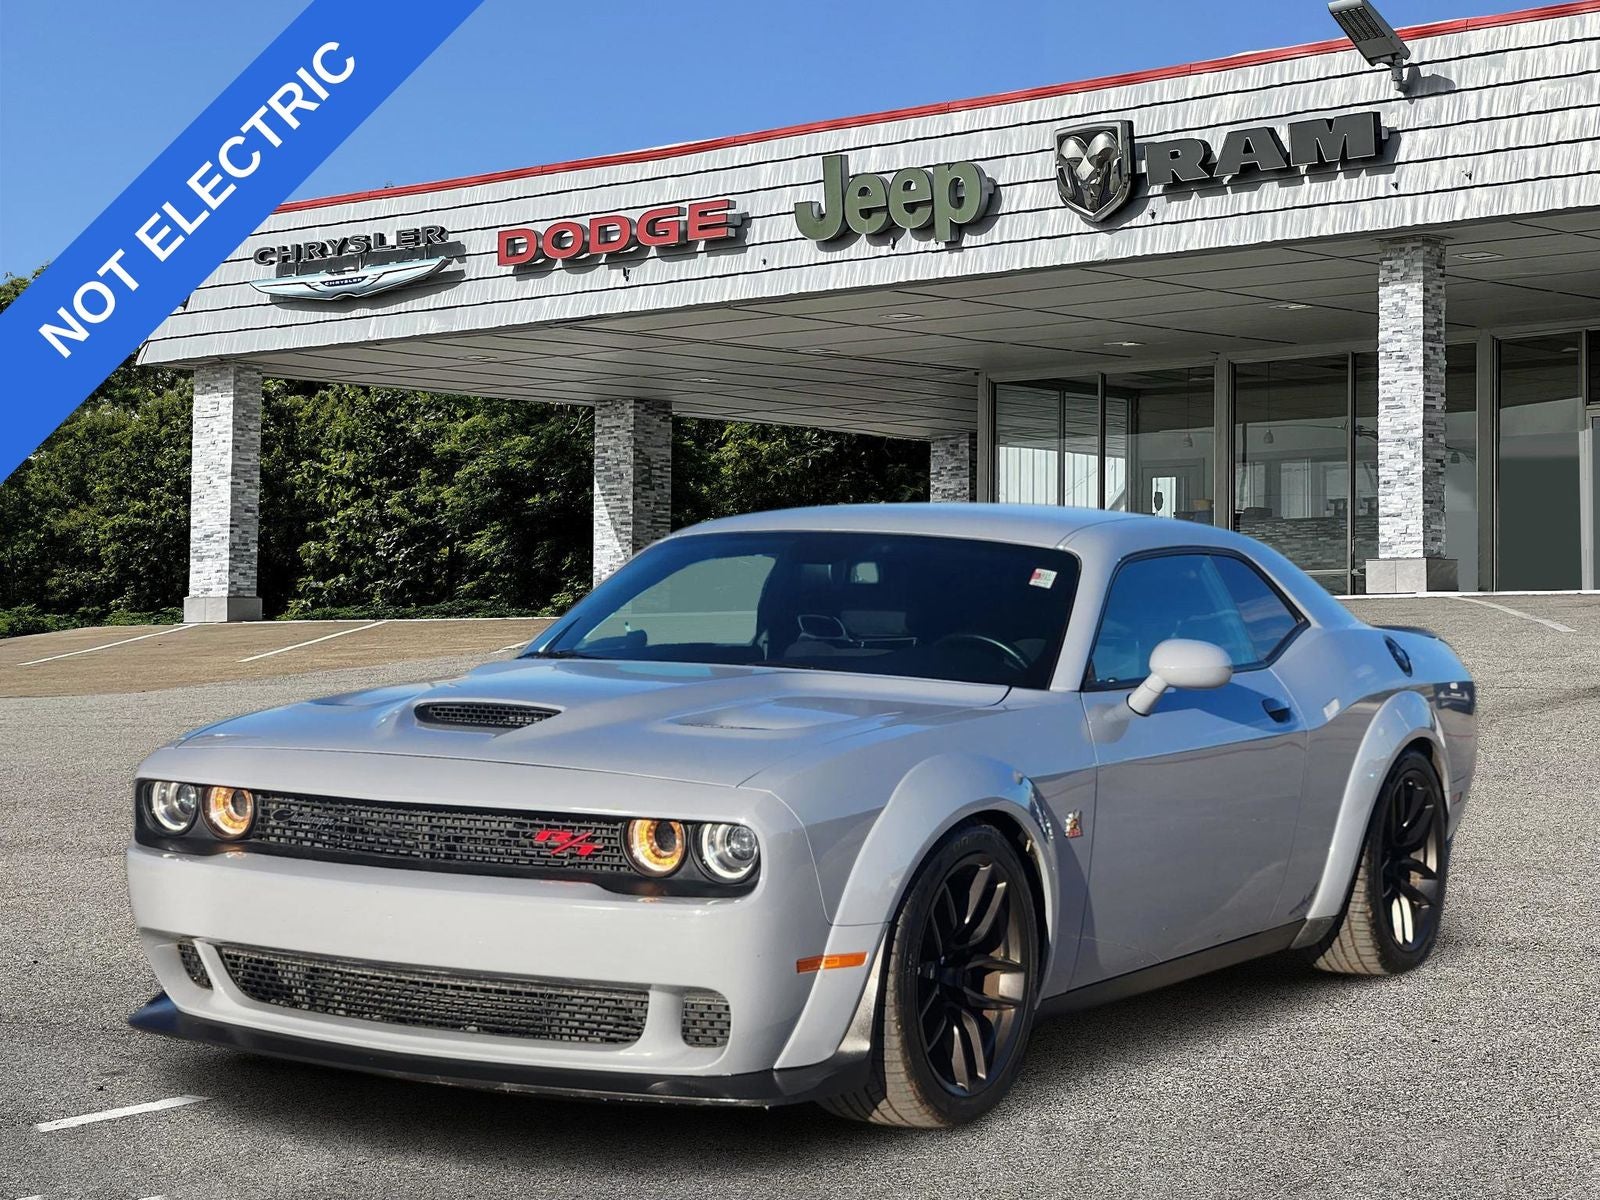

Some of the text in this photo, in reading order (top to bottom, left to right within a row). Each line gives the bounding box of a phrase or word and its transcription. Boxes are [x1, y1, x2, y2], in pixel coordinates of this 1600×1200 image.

[1145, 112, 1380, 186] RAM
[498, 199, 735, 266] DODGE
[794, 154, 988, 242] Jeep
[253, 224, 449, 266] CHRYSLER
